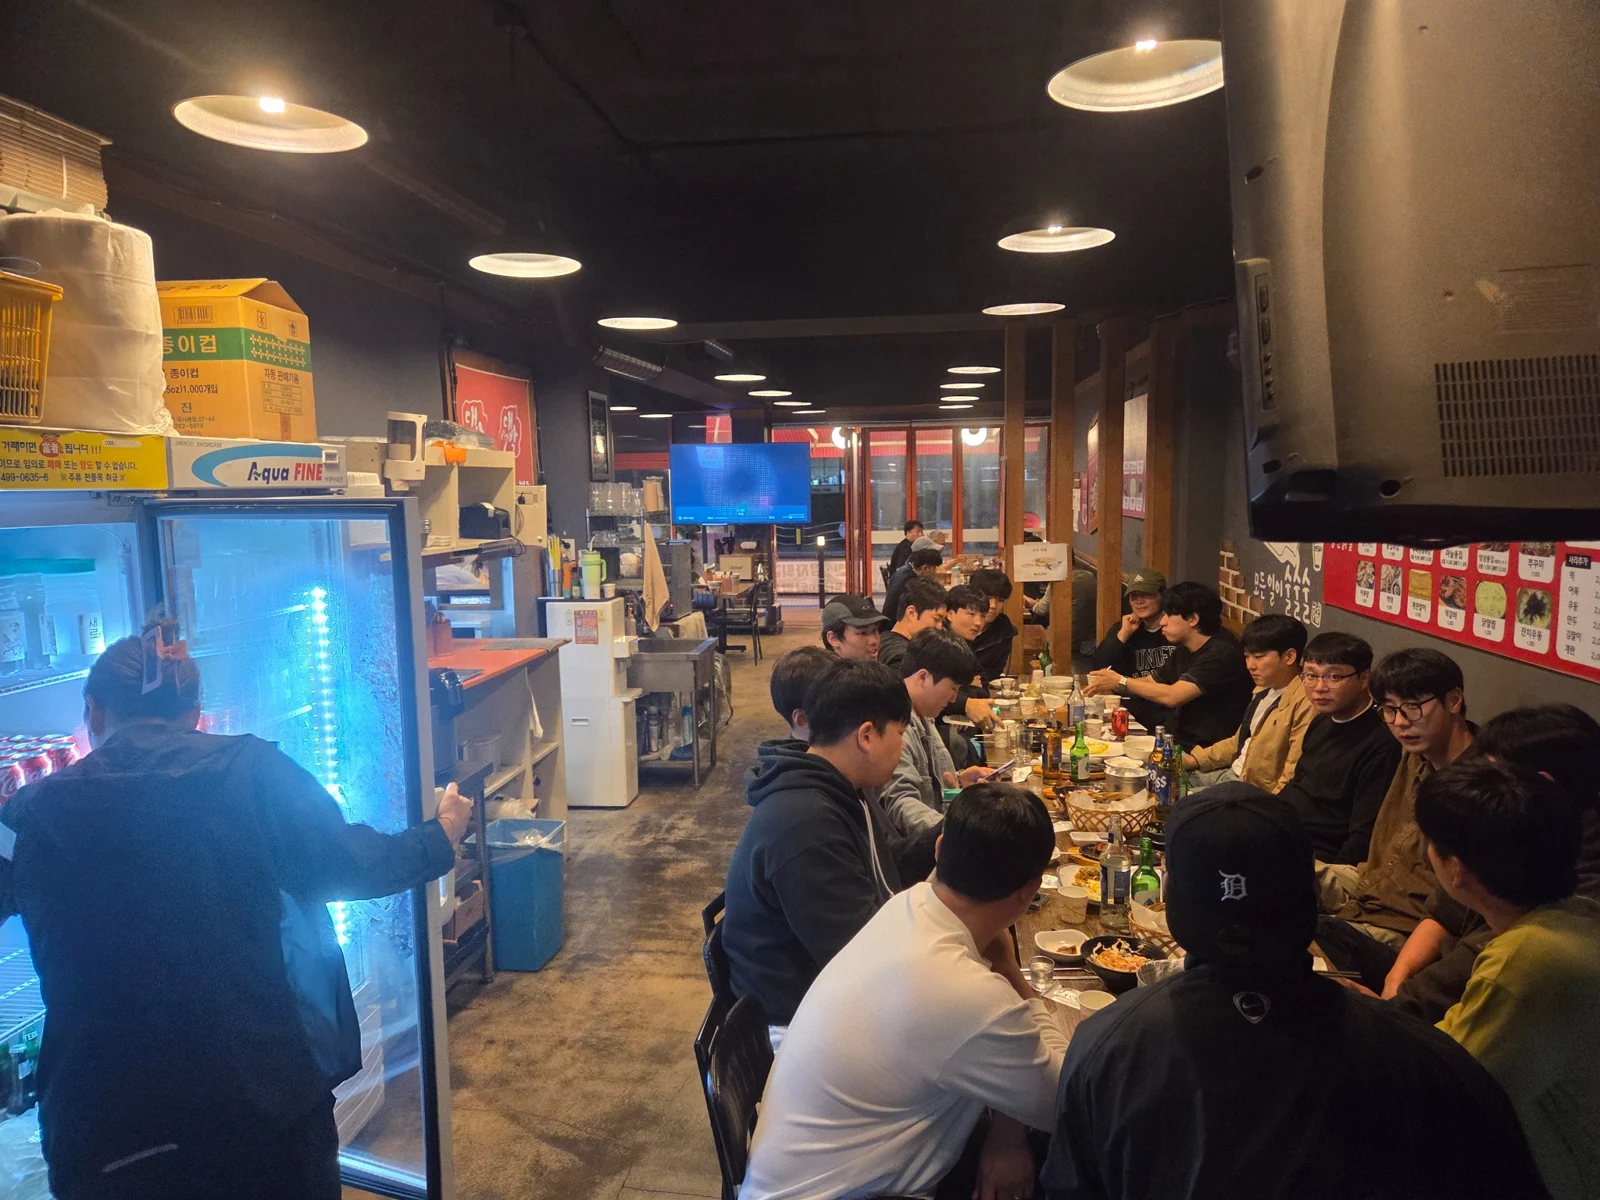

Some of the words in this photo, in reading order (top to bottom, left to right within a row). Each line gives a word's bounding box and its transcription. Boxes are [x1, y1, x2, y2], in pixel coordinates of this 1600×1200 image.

[170, 368, 199, 379] 종이컵
[264, 368, 276, 381] 자동
[277, 370, 300, 385] 판매기용
[181, 402, 193, 413] 진
[64, 443, 89, 455] 됩니다
[23, 459, 45, 470] 임의로
[64, 460, 78, 470] 또는
[80, 460, 94, 470] 양도
[104, 460, 111, 470] 수
[247, 461, 290, 484] Aqua
[293, 462, 324, 482] FINE
[1253, 571, 1266, 600] 모든
[1567, 600, 1578, 612] 우동
[1566, 615, 1577, 626] 만두
[1218, 869, 1248, 901] D
